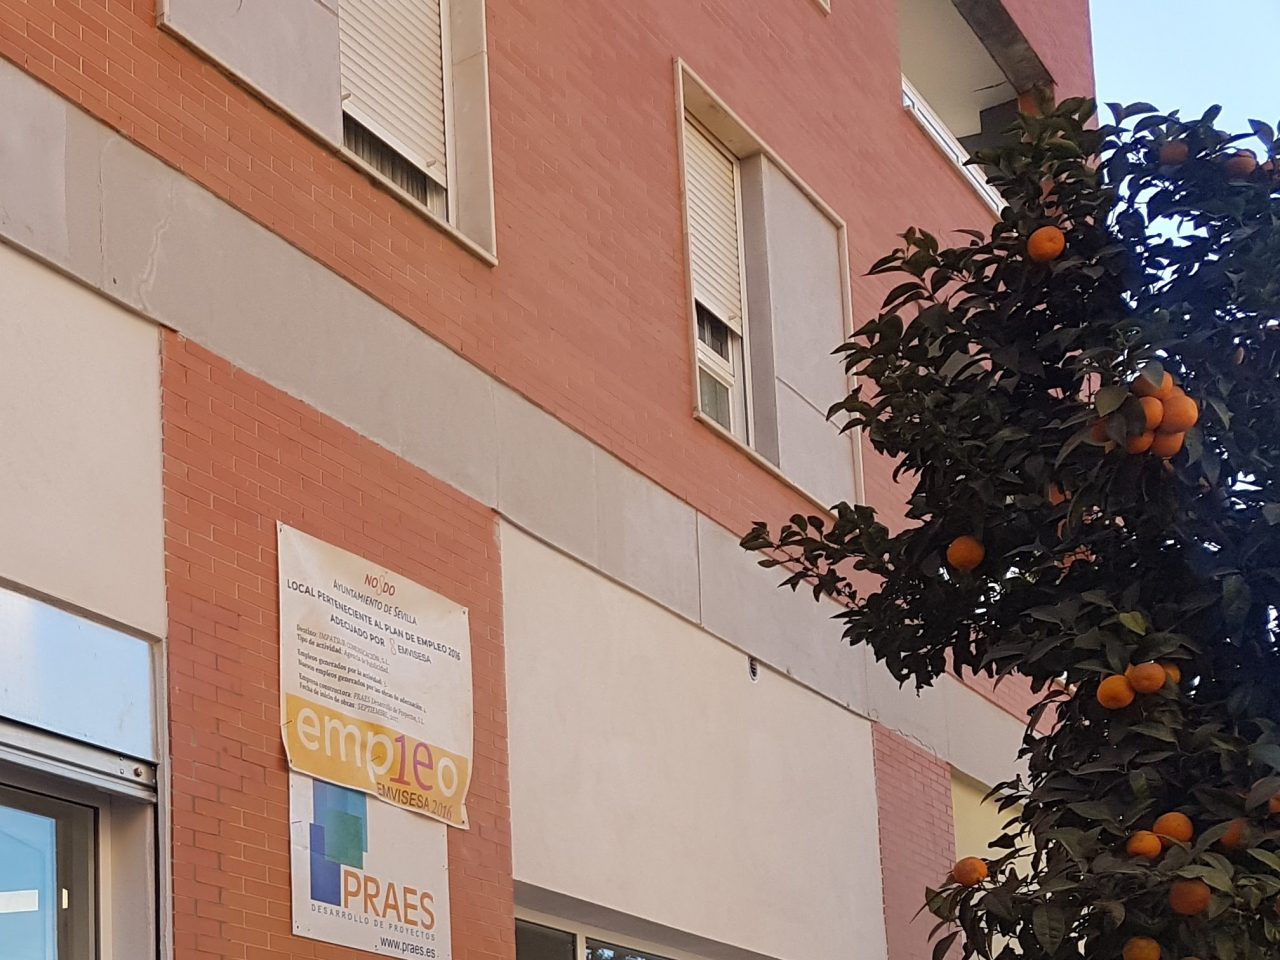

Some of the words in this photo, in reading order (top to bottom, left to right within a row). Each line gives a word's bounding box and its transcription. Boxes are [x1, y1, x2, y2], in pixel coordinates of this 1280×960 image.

[287, 579, 315, 597] LOCAL
[318, 590, 373, 625] PERTENECIENTE
[374, 620, 384, 631] AL
[384, 623, 404, 638] PLAN
[405, 632, 415, 643] DE
[417, 636, 447, 654] EMPLEO
[448, 647, 461, 661] 2016
[333, 579, 383, 610] AYUNTAMIENTO
[384, 604, 392, 615] DE
[393, 606, 417, 625] SEVILLA
[330, 614, 368, 640] ADECUADO
[370, 633, 386, 647] POR
[376, 782, 430, 810] EMVISESA
[431, 800, 453, 820] 2016
[343, 869, 435, 931] PRAES
[311, 903, 369, 925] DESARROLLO
[373, 919, 384, 929] DE
[388, 923, 436, 941] PROYECTOS
[380, 936, 436, 959] www.praes.es
